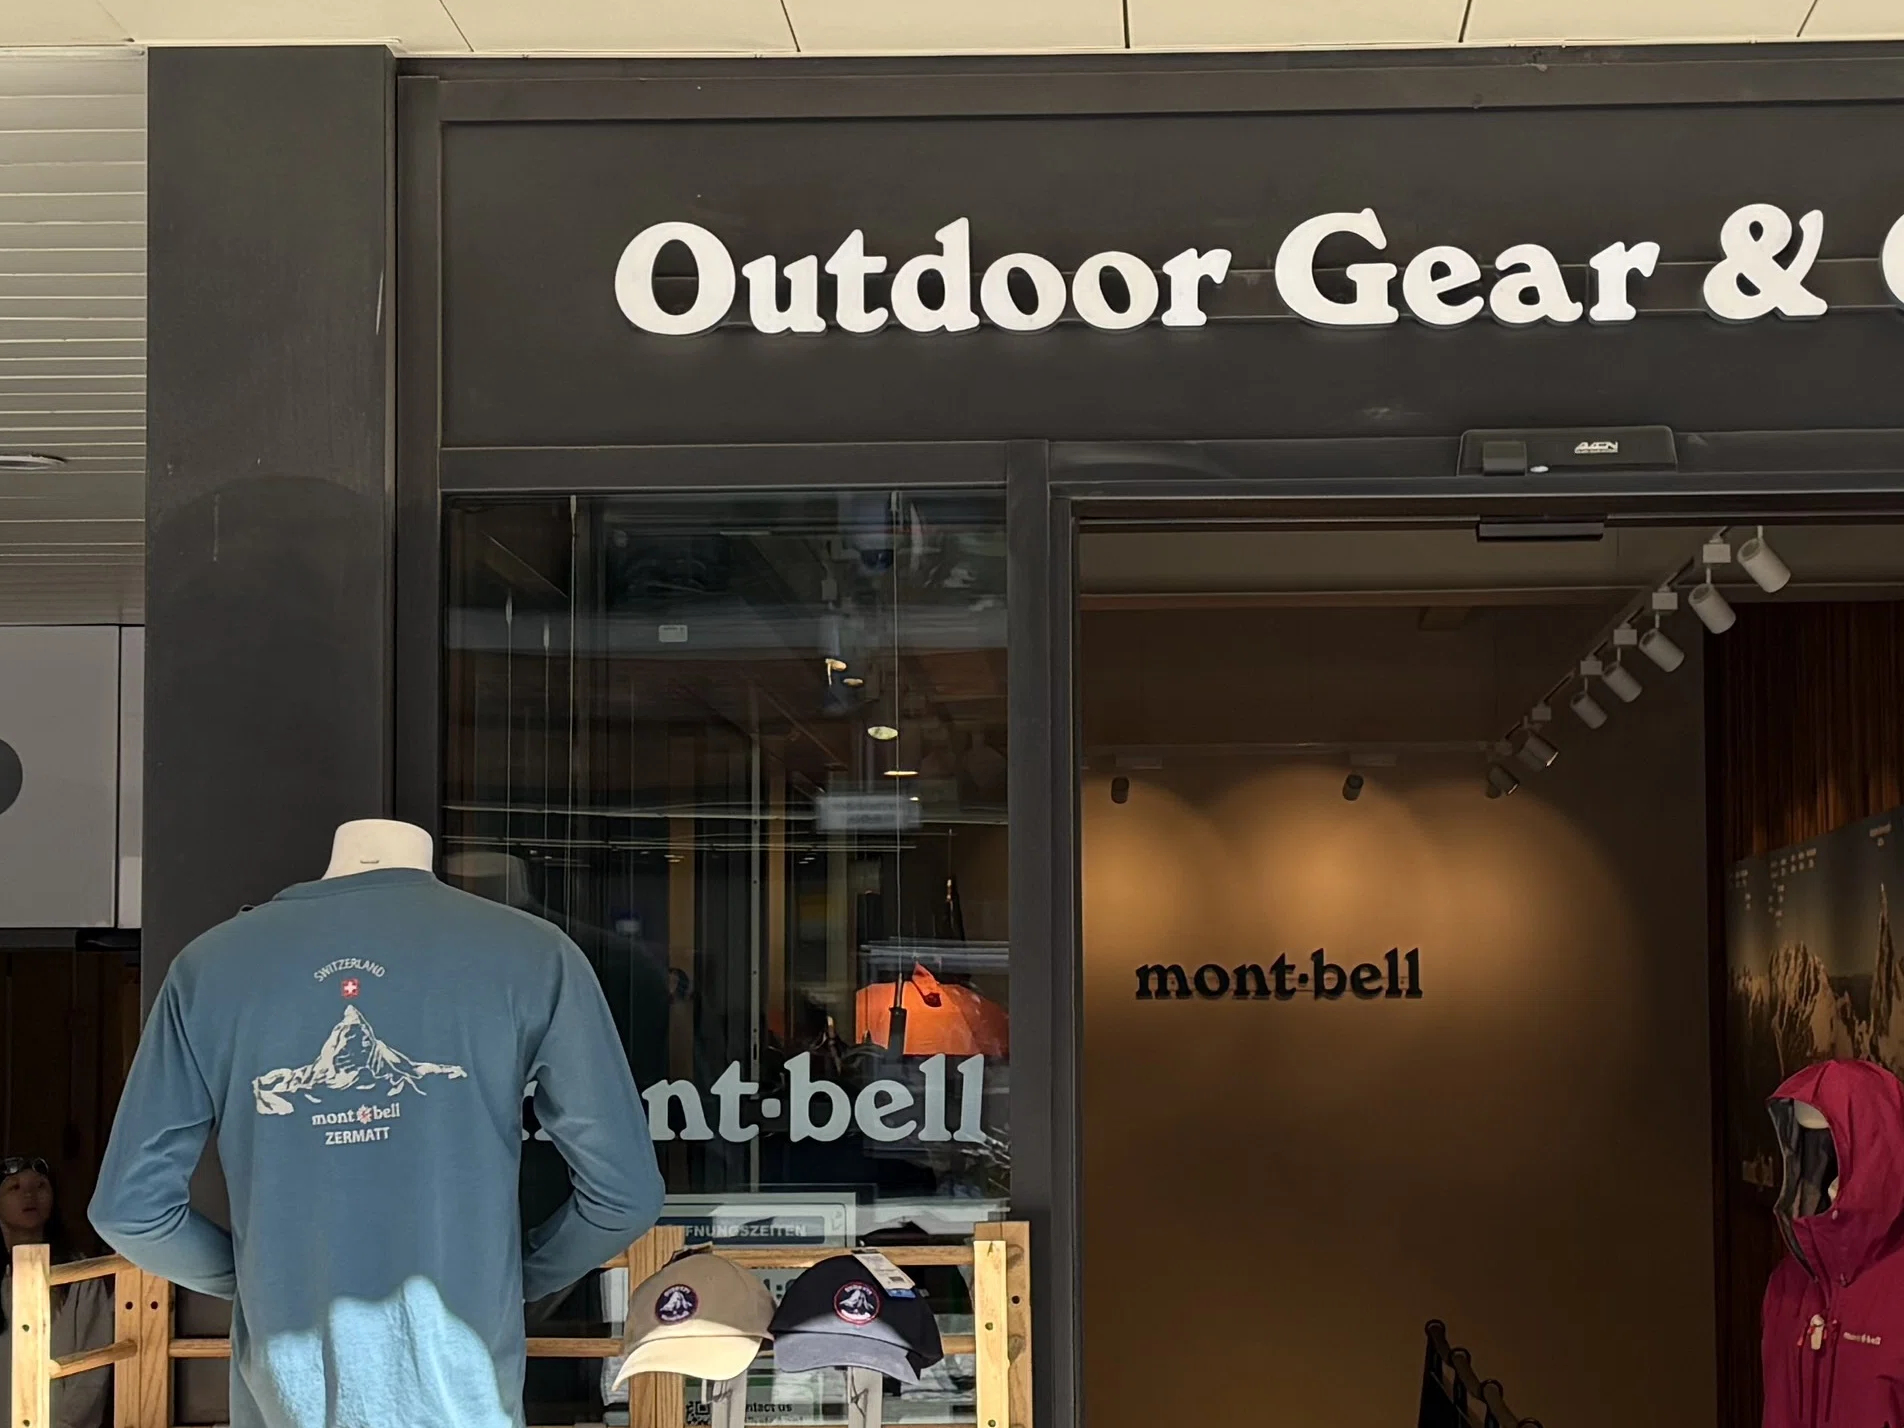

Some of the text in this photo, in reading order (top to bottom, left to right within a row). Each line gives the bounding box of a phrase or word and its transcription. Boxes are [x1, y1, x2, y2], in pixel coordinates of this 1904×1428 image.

[613, 218, 1232, 335] Outdoor
[1275, 210, 1660, 329] Gear
[1702, 202, 1830, 322] &
[313, 958, 385, 982] SWITZERLAND
[325, 1126, 391, 1146] ZERMATT
